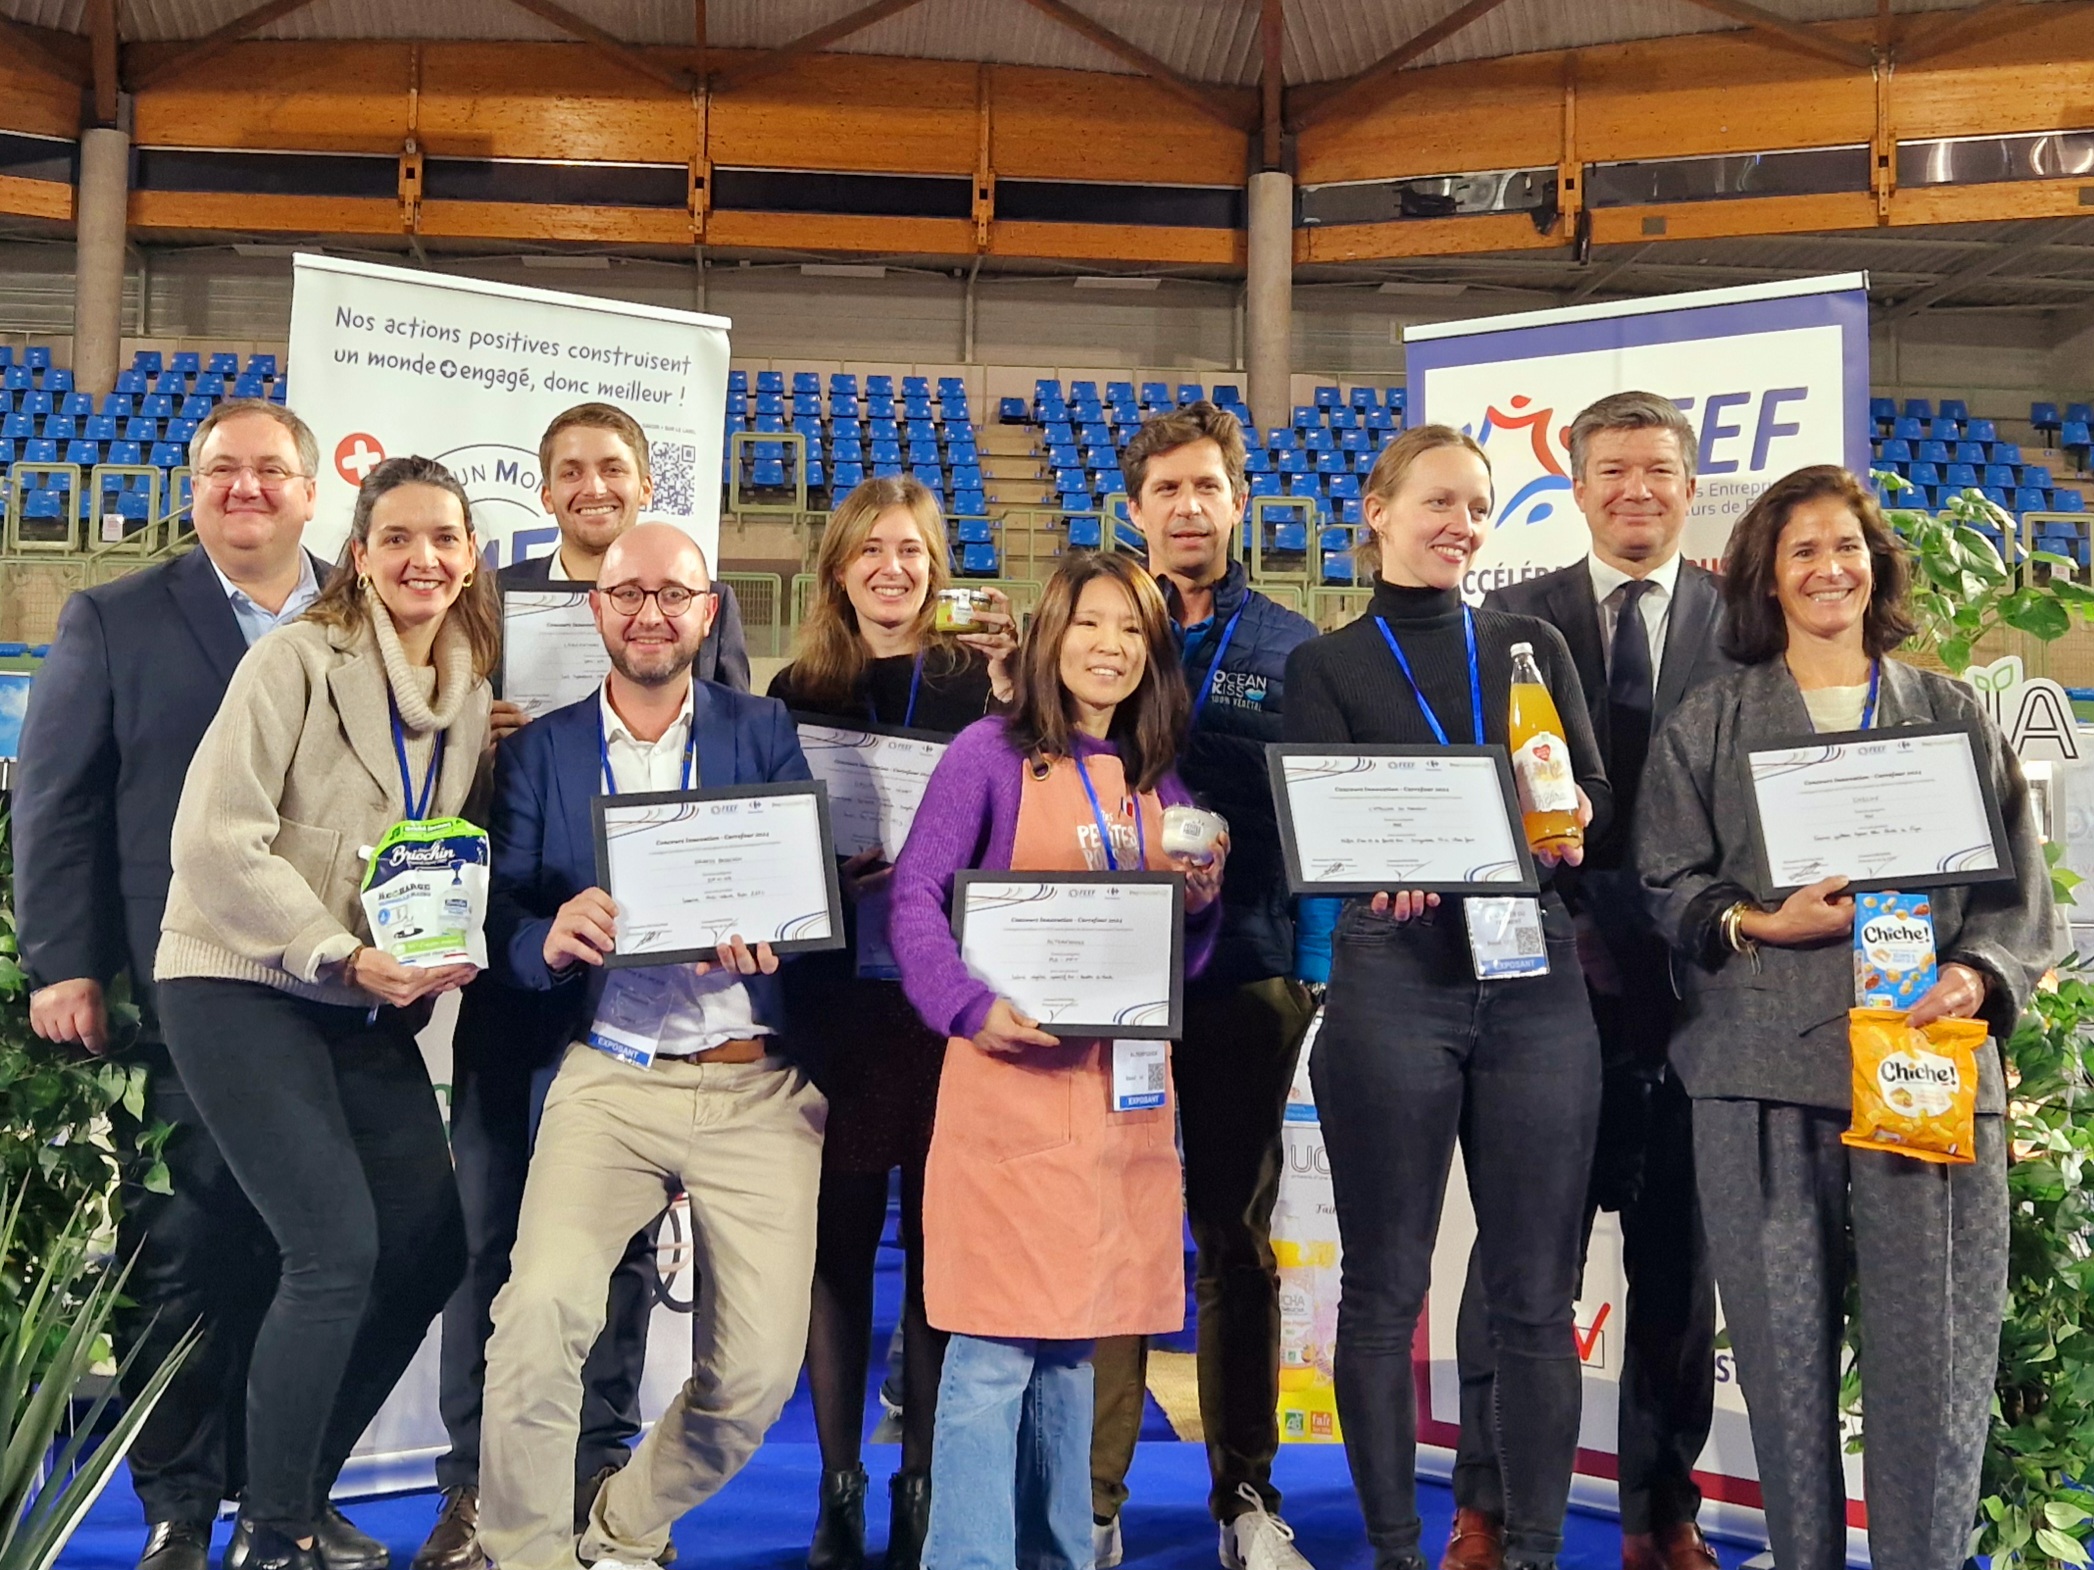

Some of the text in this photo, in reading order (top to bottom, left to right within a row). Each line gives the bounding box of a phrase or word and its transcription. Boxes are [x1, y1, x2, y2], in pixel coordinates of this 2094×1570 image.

[335, 305, 692, 376] Nos actions positives construisent
[334, 349, 686, 407] un monde engagé, donc meilleur !
[1669, 386, 1808, 475] EF
[1695, 481, 1773, 498] s Entrepri
[1686, 504, 1716, 516] urs
[1721, 500, 1741, 515] de
[1213, 670, 1267, 690] OCEAN
[1211, 682, 1245, 698] KISS
[1874, 771, 1906, 780] Carrefour
[1403, 786, 1435, 794] Carrefour
[724, 831, 754, 841] Carrefour
[1076, 821, 1139, 849] PEITES
[389, 841, 456, 867] Briochin
[1077, 916, 1108, 924] Carrefour
[1864, 925, 1931, 944] Chiche!
[1495, 960, 1535, 970] XPOSANT
[597, 1036, 639, 1058] EXPOSANT
[1881, 1061, 1958, 1085] Chiche!
[1280, 1294, 1305, 1307] CHA
